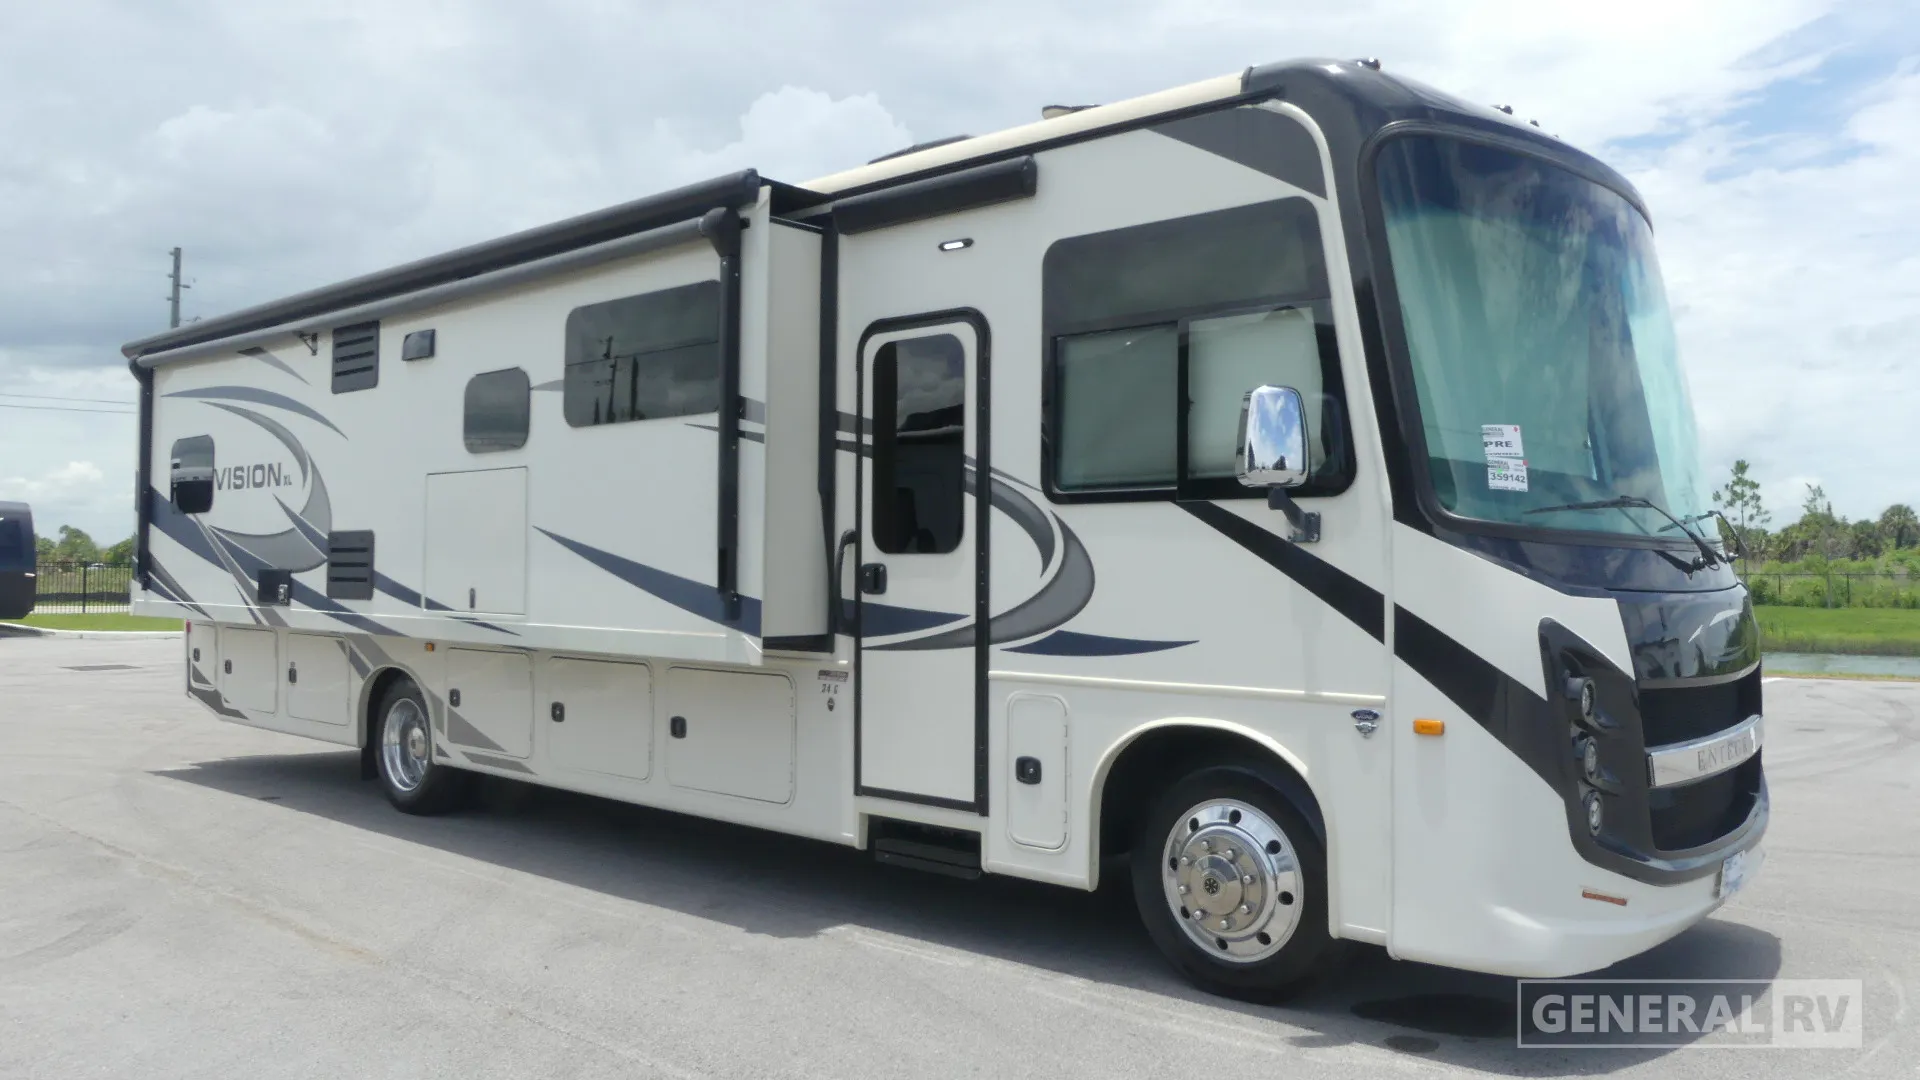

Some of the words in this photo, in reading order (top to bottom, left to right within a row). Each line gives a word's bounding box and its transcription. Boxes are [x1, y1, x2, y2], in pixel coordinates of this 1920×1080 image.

[213, 462, 282, 491] VISION
[283, 474, 293, 487] XL
[1490, 472, 1526, 483] 359142
